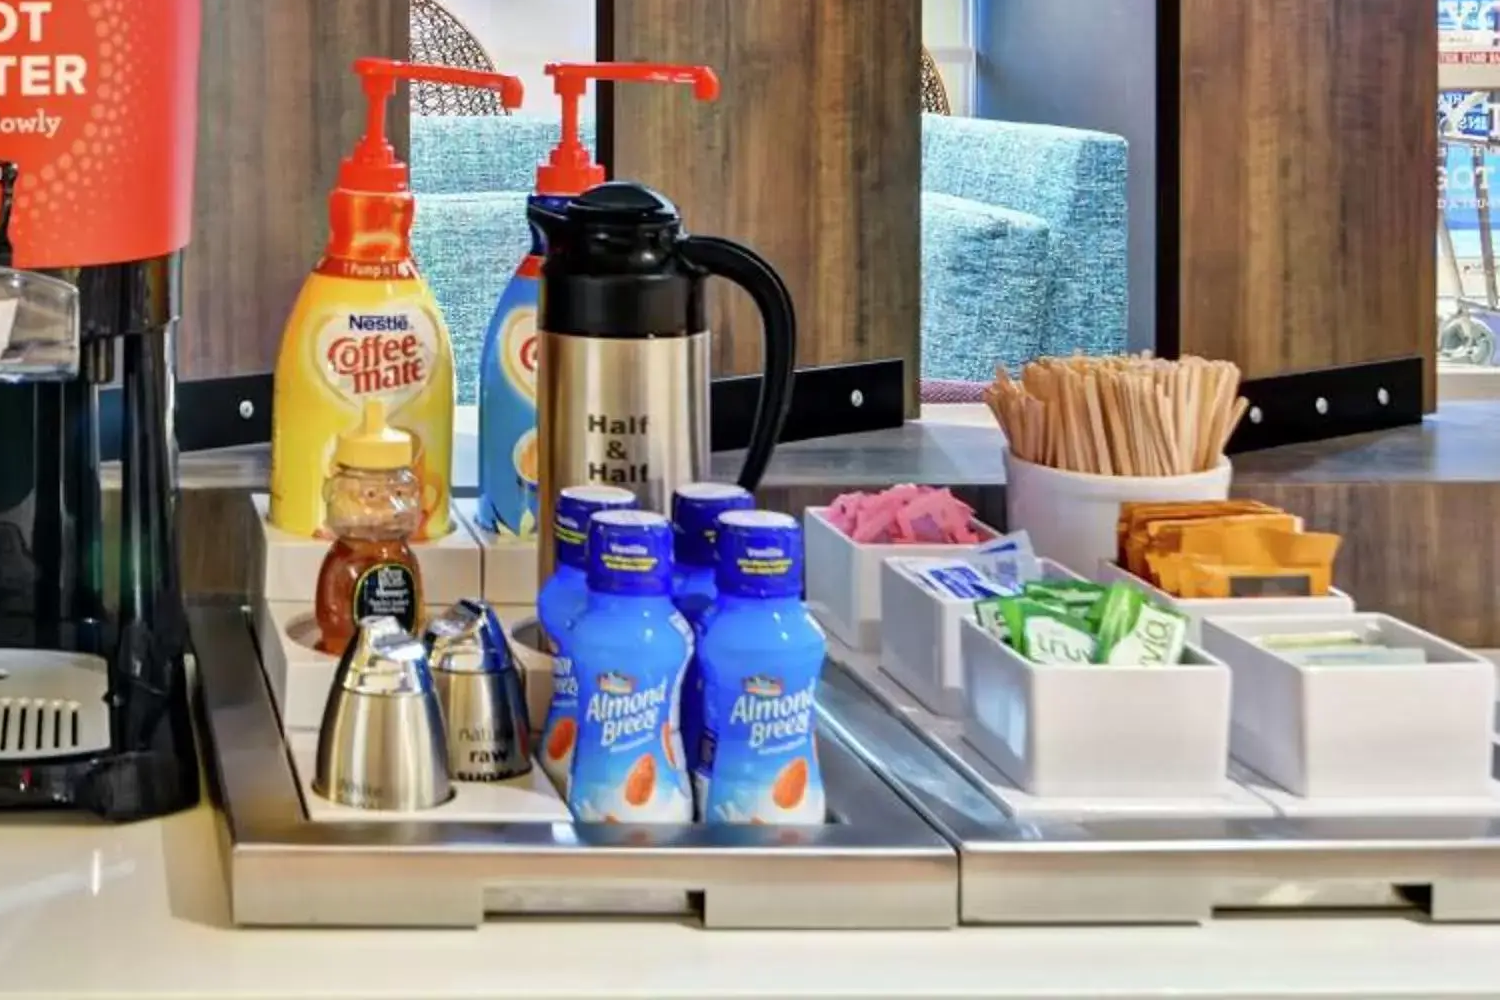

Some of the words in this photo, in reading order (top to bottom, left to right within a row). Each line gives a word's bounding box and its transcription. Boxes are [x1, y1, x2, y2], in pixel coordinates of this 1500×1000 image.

[327, 333, 418, 375] Coffee
[353, 358, 426, 395] mate
[588, 414, 648, 435] Half
[606, 440, 627, 460] &
[588, 462, 648, 484] Half
[586, 675, 668, 722] Almond
[729, 677, 816, 725] Almond
[469, 750, 508, 763] raw
